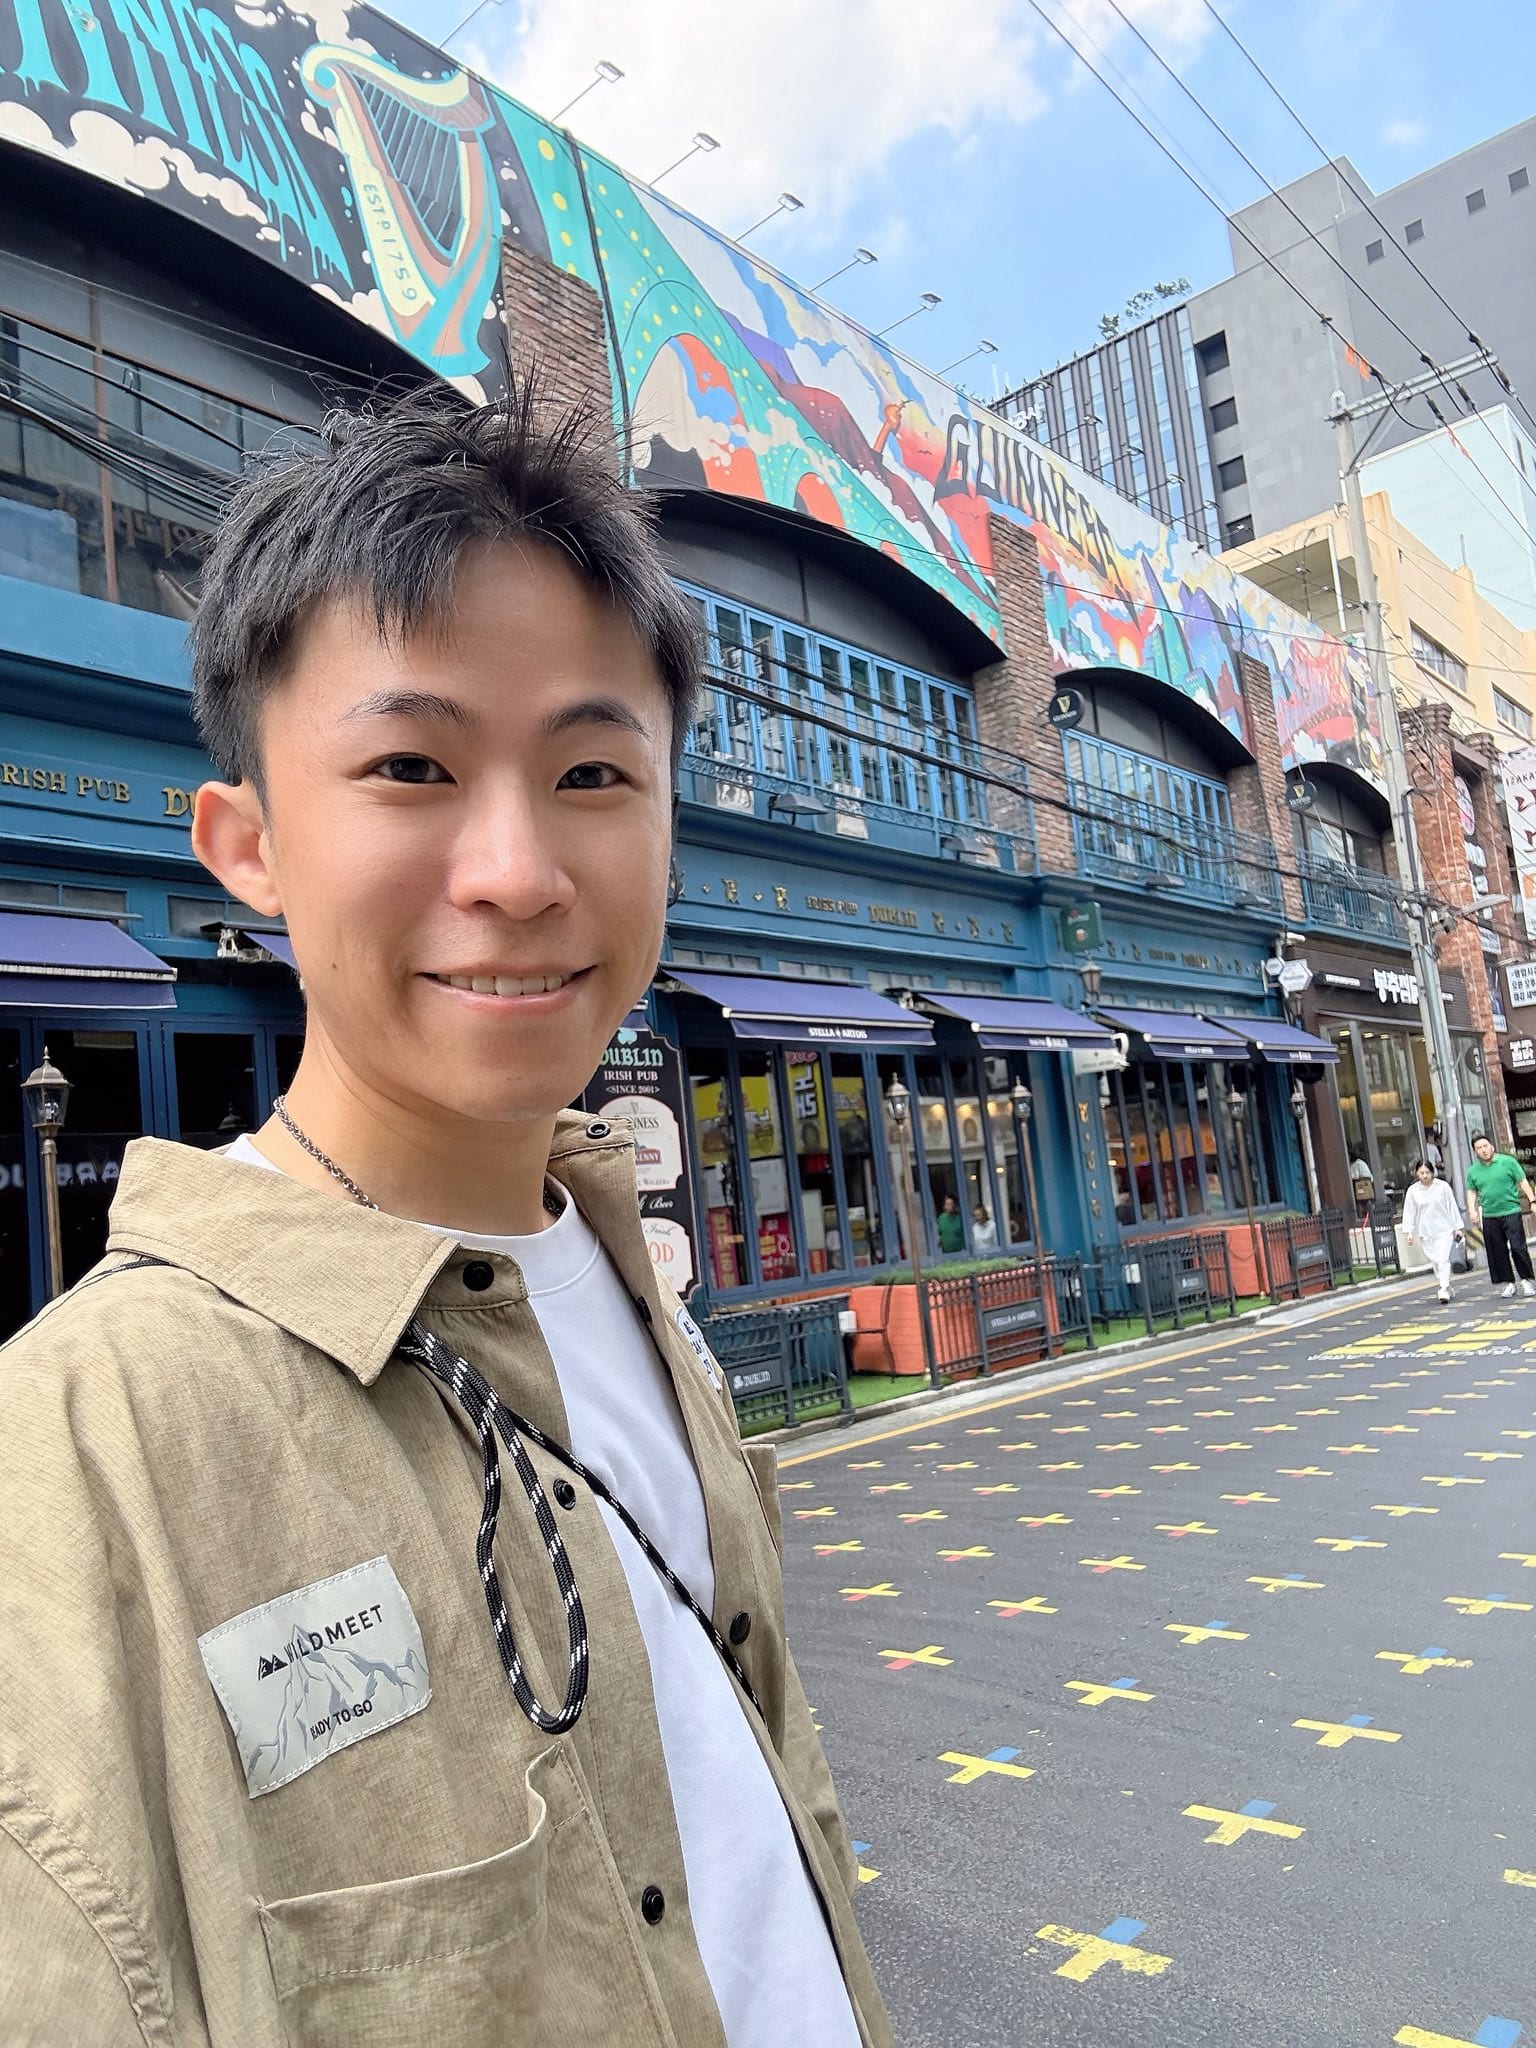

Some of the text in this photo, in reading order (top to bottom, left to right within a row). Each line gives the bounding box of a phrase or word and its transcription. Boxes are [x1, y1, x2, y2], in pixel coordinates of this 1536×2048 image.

[381, 238, 418, 301] 1759
[0, 762, 68, 794] RISH
[76, 775, 131, 803] PUB
[1505, 770, 1536, 788] IZAKA
[808, 1026, 868, 1039] STELLA ARTOIS
[604, 1070, 659, 1081] IRISH PUB
[743, 1371, 771, 1387] DUBLIN
[333, 1709, 351, 1727] TO
[353, 1699, 373, 1718] GO
